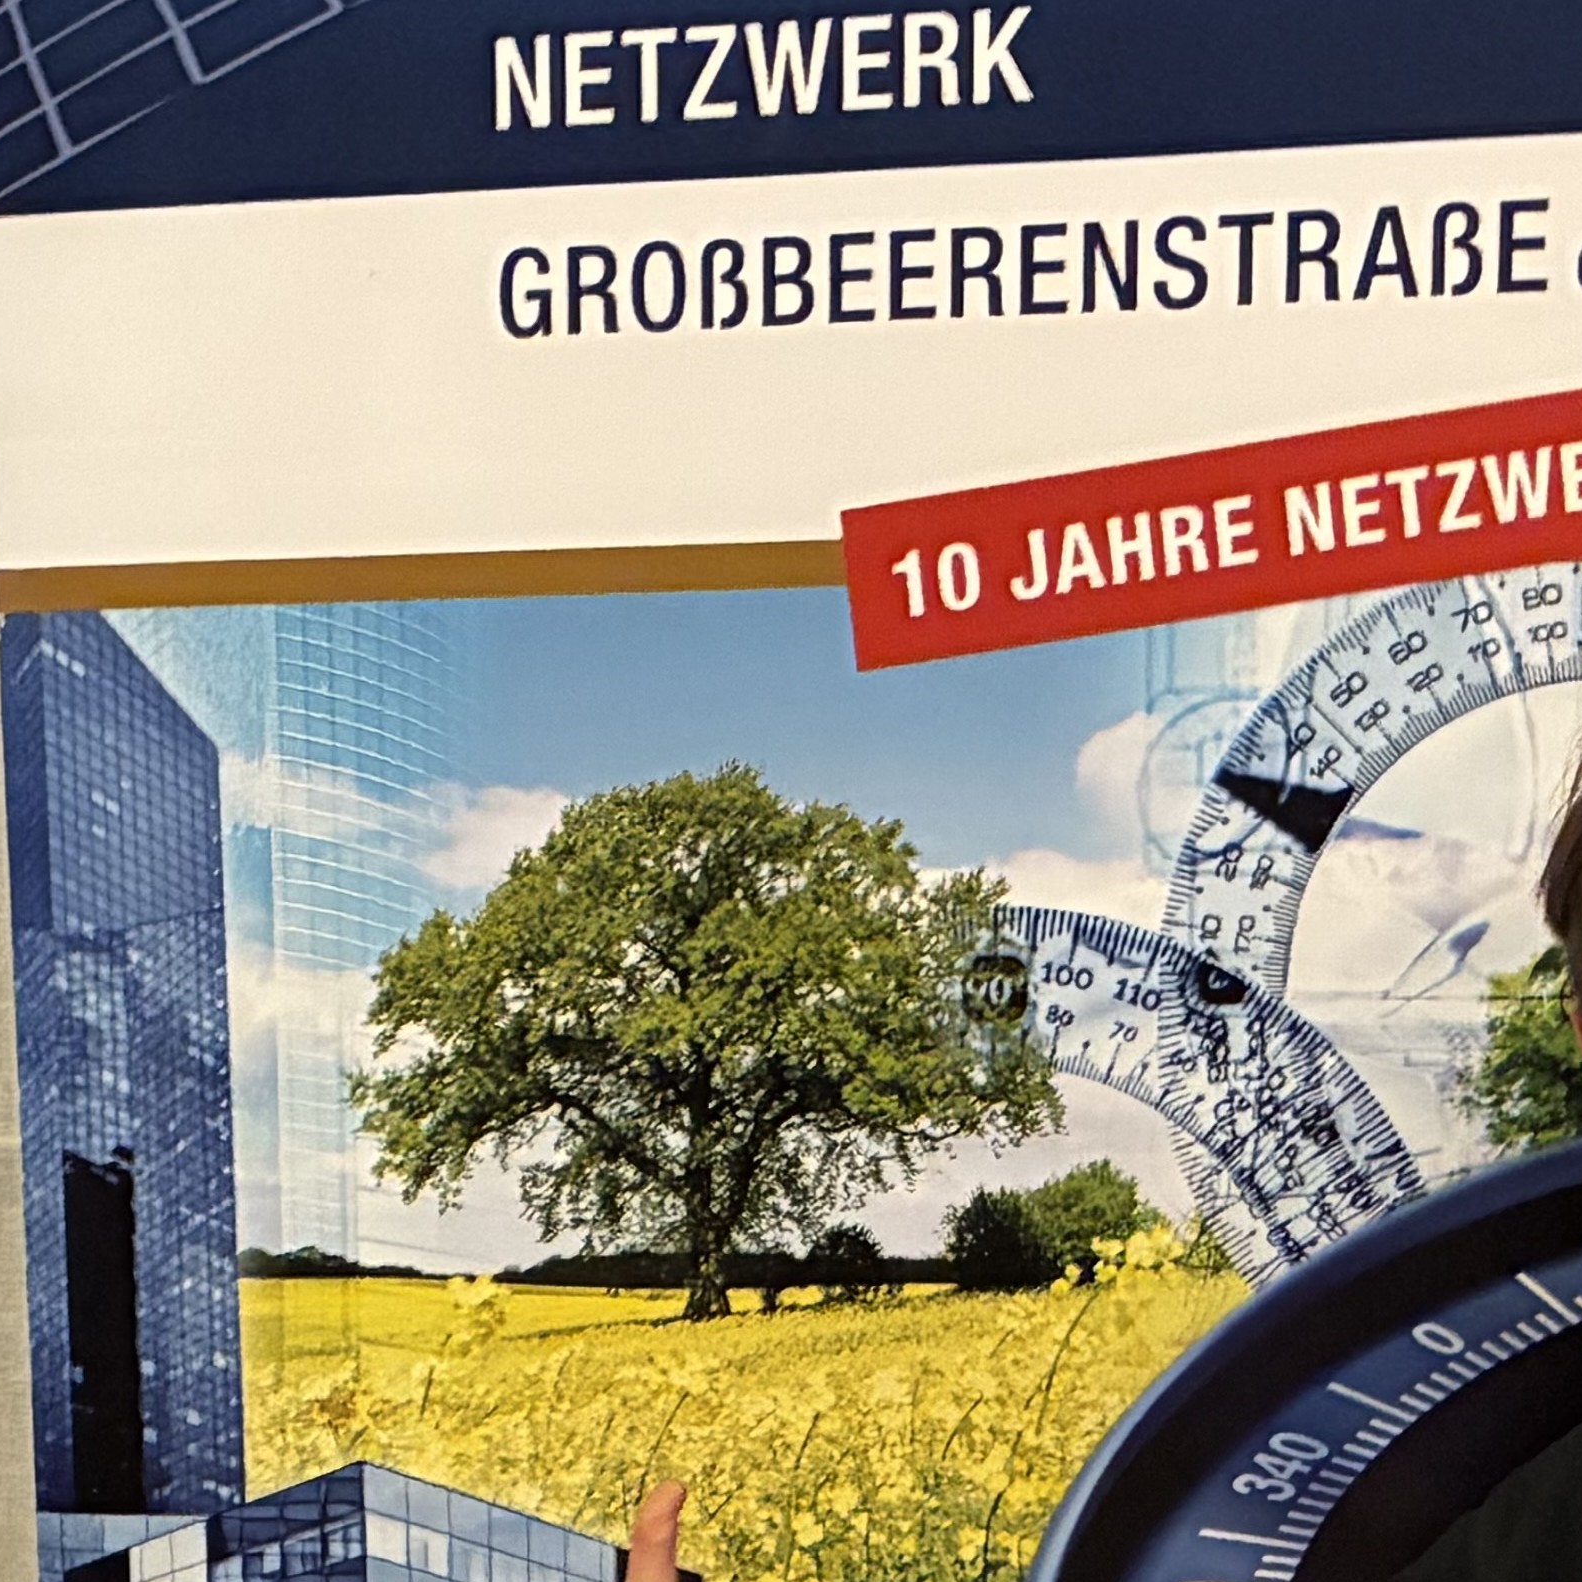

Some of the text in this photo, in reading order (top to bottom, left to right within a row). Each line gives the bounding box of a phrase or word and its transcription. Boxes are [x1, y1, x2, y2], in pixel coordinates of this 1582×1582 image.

[493, 6, 1034, 131] NETZWERK
[890, 539, 981, 619] 10
[1008, 493, 1260, 603] JAHRE
[1521, 582, 1563, 612] 80
[1451, 601, 1494, 633] 70
[1041, 961, 1094, 991] 100
[1411, 1321, 1465, 1357] 0
[1232, 1430, 1330, 1503] 340
